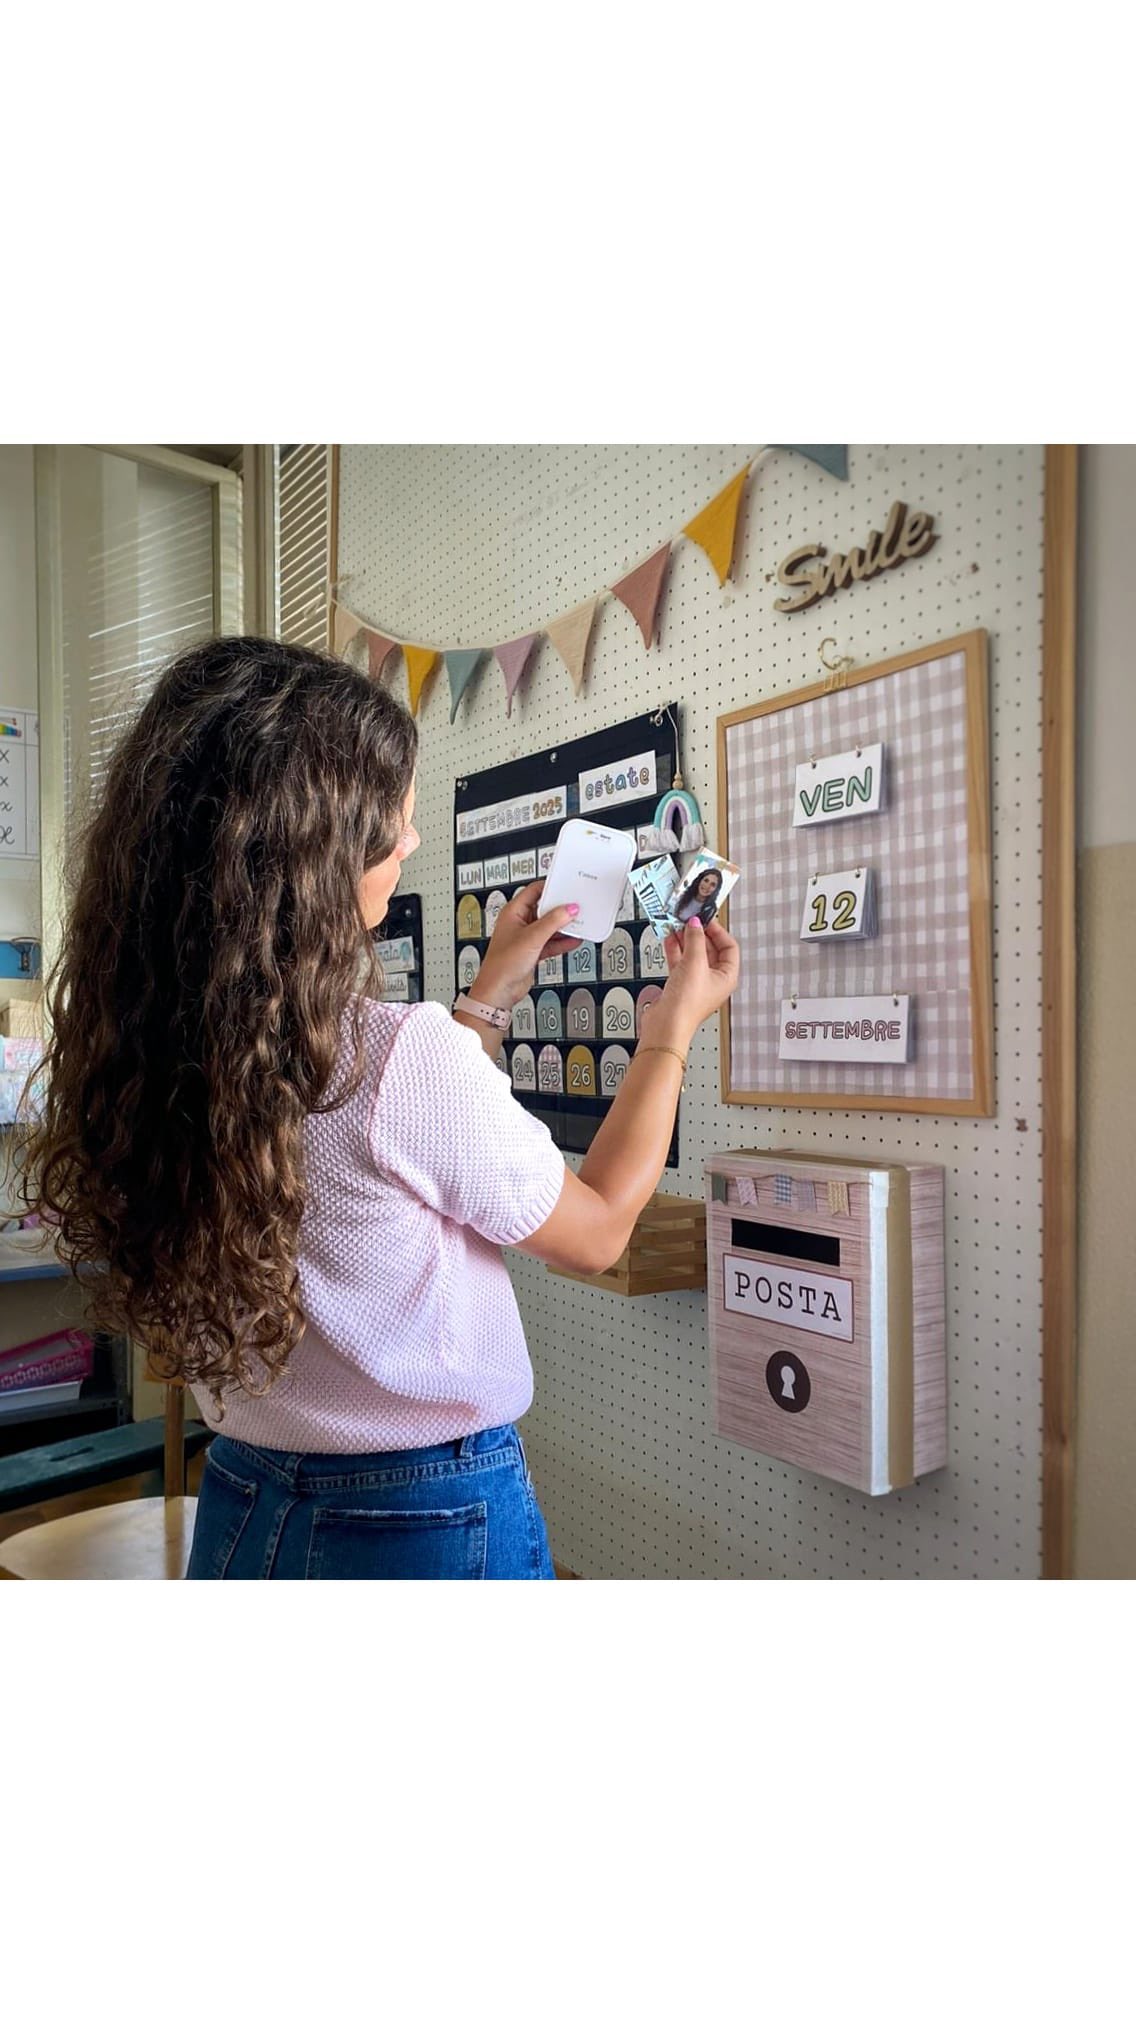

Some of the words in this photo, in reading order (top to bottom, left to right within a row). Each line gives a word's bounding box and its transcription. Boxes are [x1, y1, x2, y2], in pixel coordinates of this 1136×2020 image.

[773, 500, 941, 614] Smile
[585, 766, 650, 800] estate
[799, 766, 873, 817] VEN
[460, 805, 531, 838] SETTEMBRE
[532, 796, 563, 820] 2025
[461, 867, 482, 886] LUN
[486, 862, 508, 881] MAR
[512, 857, 535, 877] MER
[466, 912, 473, 931] 1
[809, 890, 857, 932] 12
[464, 961, 475, 984] 8
[544, 958, 557, 976] 11
[573, 947, 592, 973] 12
[608, 945, 628, 973] 13
[645, 943, 665, 970] 14
[516, 1008, 531, 1030] 17
[541, 1006, 558, 1031] 18
[573, 1006, 590, 1032] 19
[606, 1005, 632, 1032] 20
[785, 1019, 901, 1041] SETTEMBRE
[514, 1057, 533, 1082] 24
[541, 1062, 560, 1086] 25
[571, 1063, 591, 1087] 26
[604, 1061, 626, 1087] 27
[734, 1270, 842, 1322] POSTA
